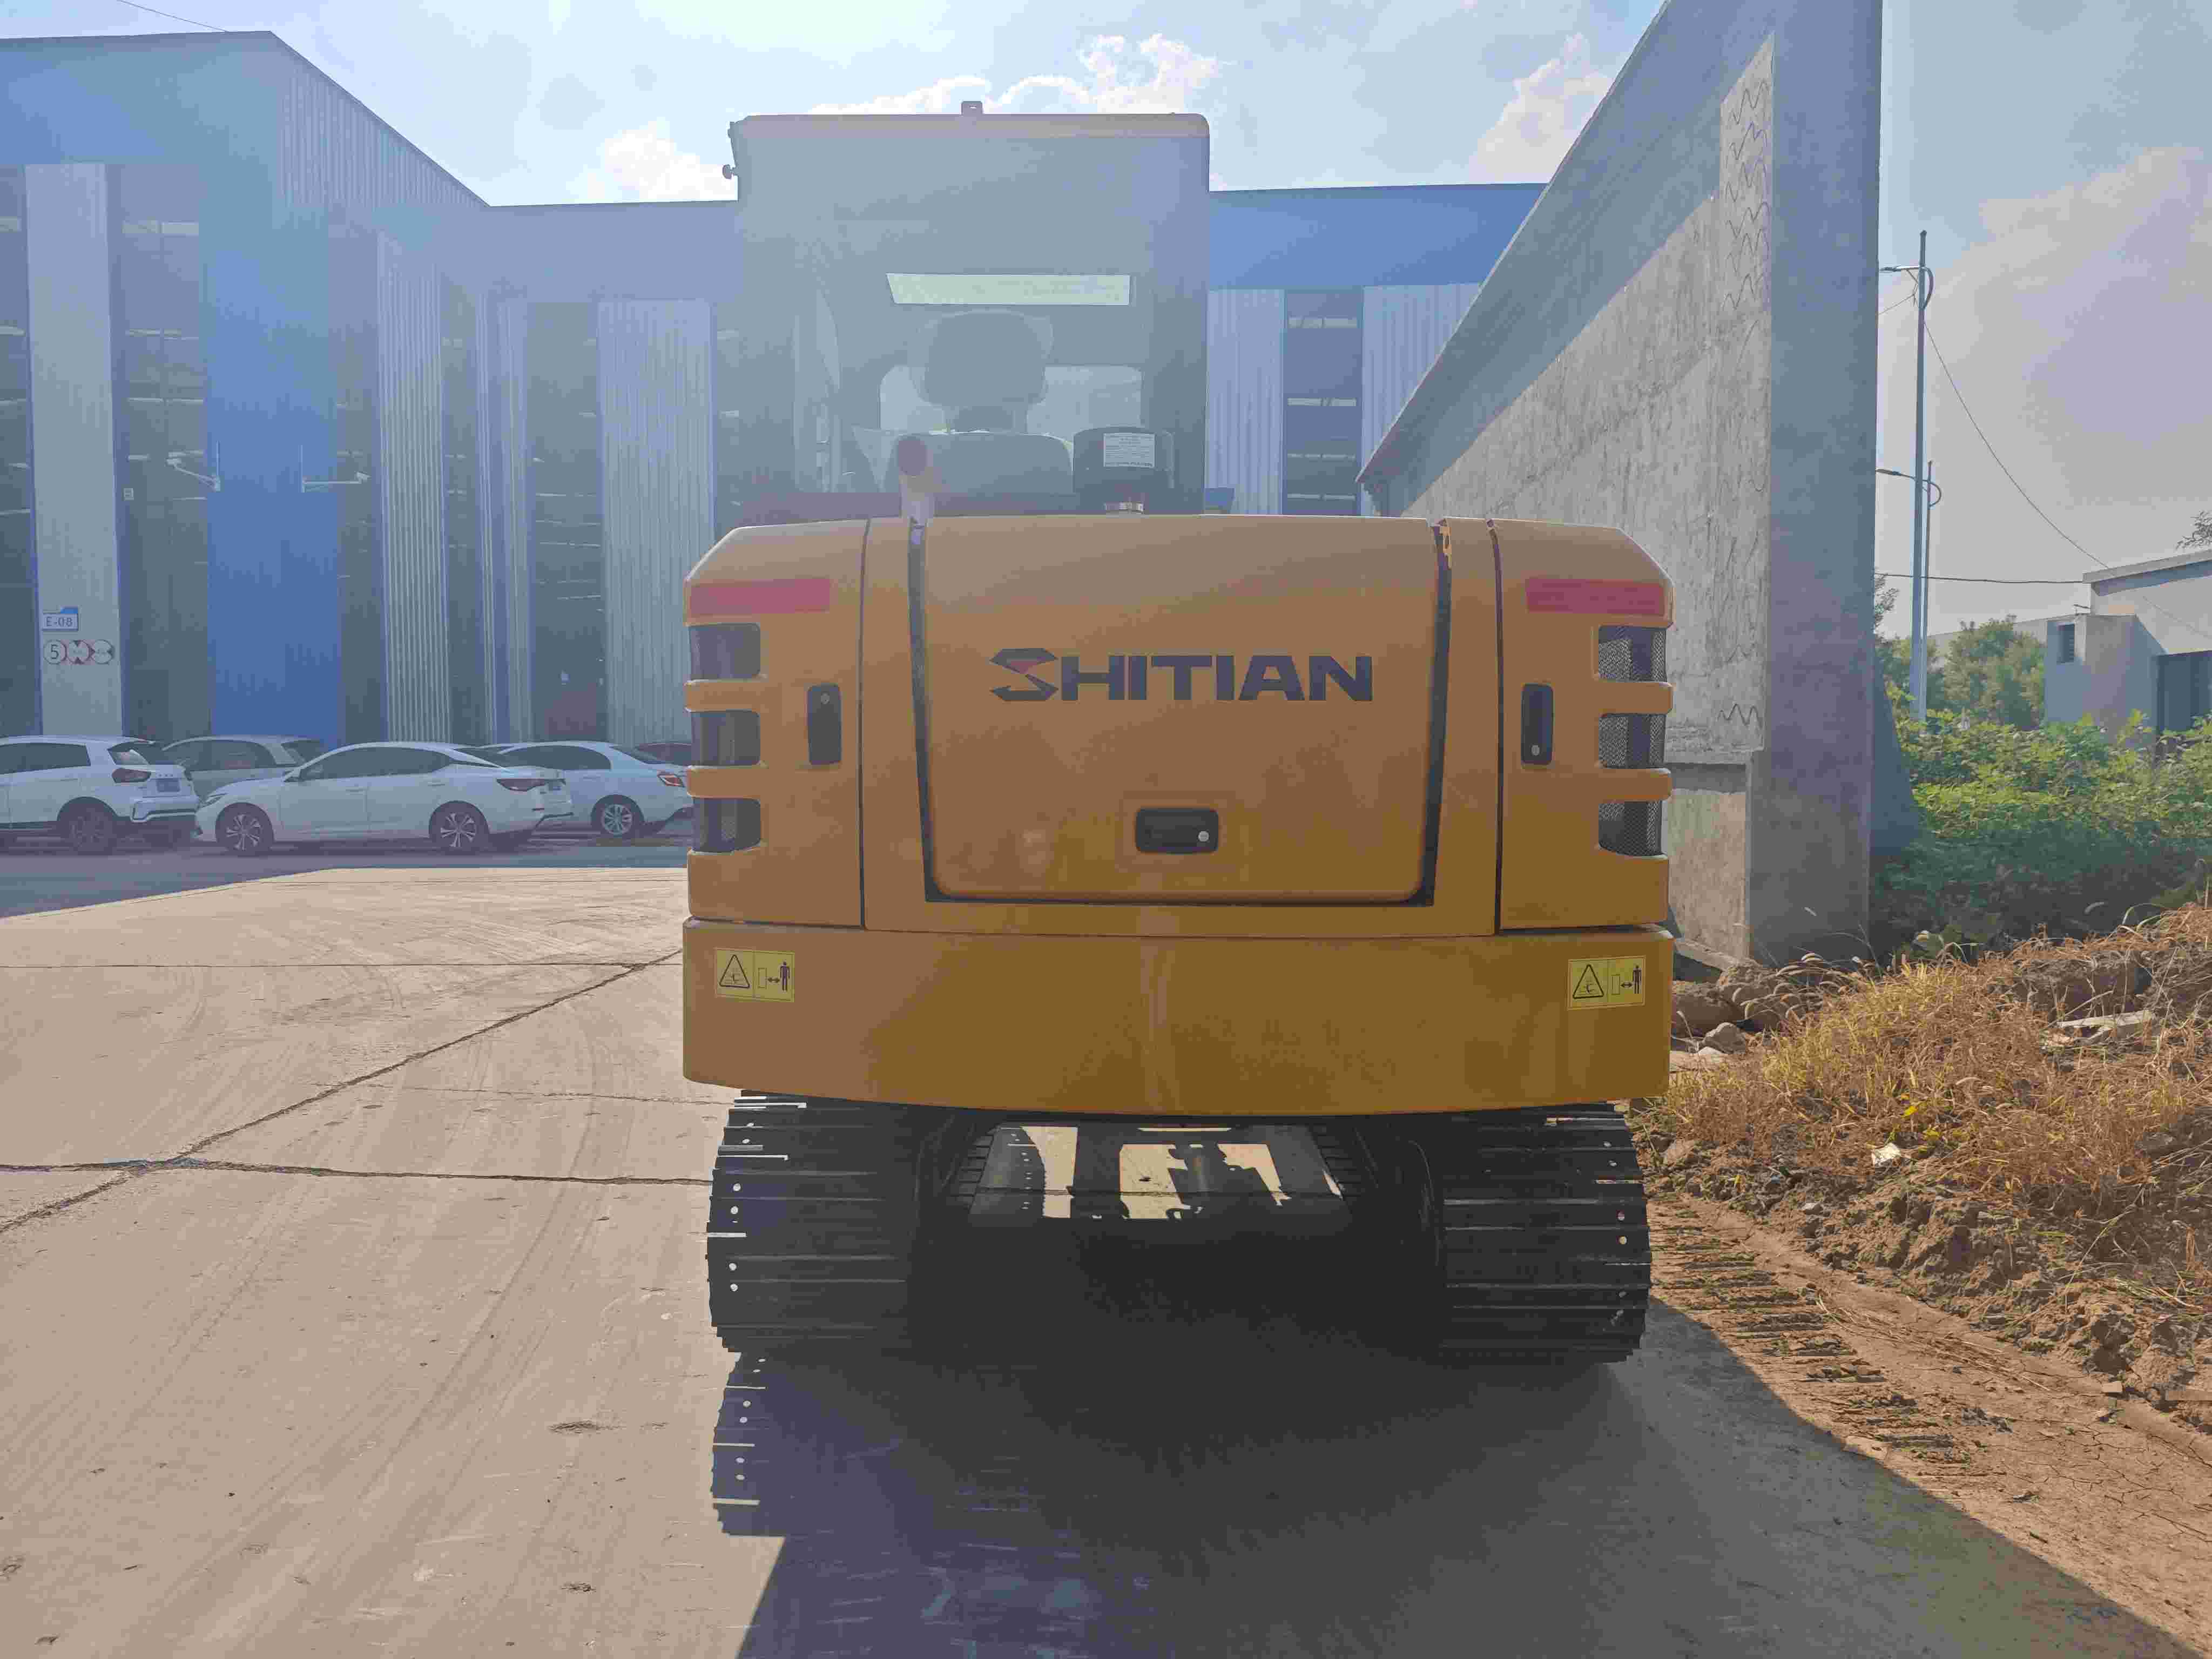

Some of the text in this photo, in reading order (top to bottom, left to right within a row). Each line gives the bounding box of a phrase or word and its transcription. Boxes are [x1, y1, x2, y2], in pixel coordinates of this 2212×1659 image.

[46, 616, 73, 627] E-08
[50, 644, 59, 659] 5
[989, 648, 1373, 701] SHITIAN
